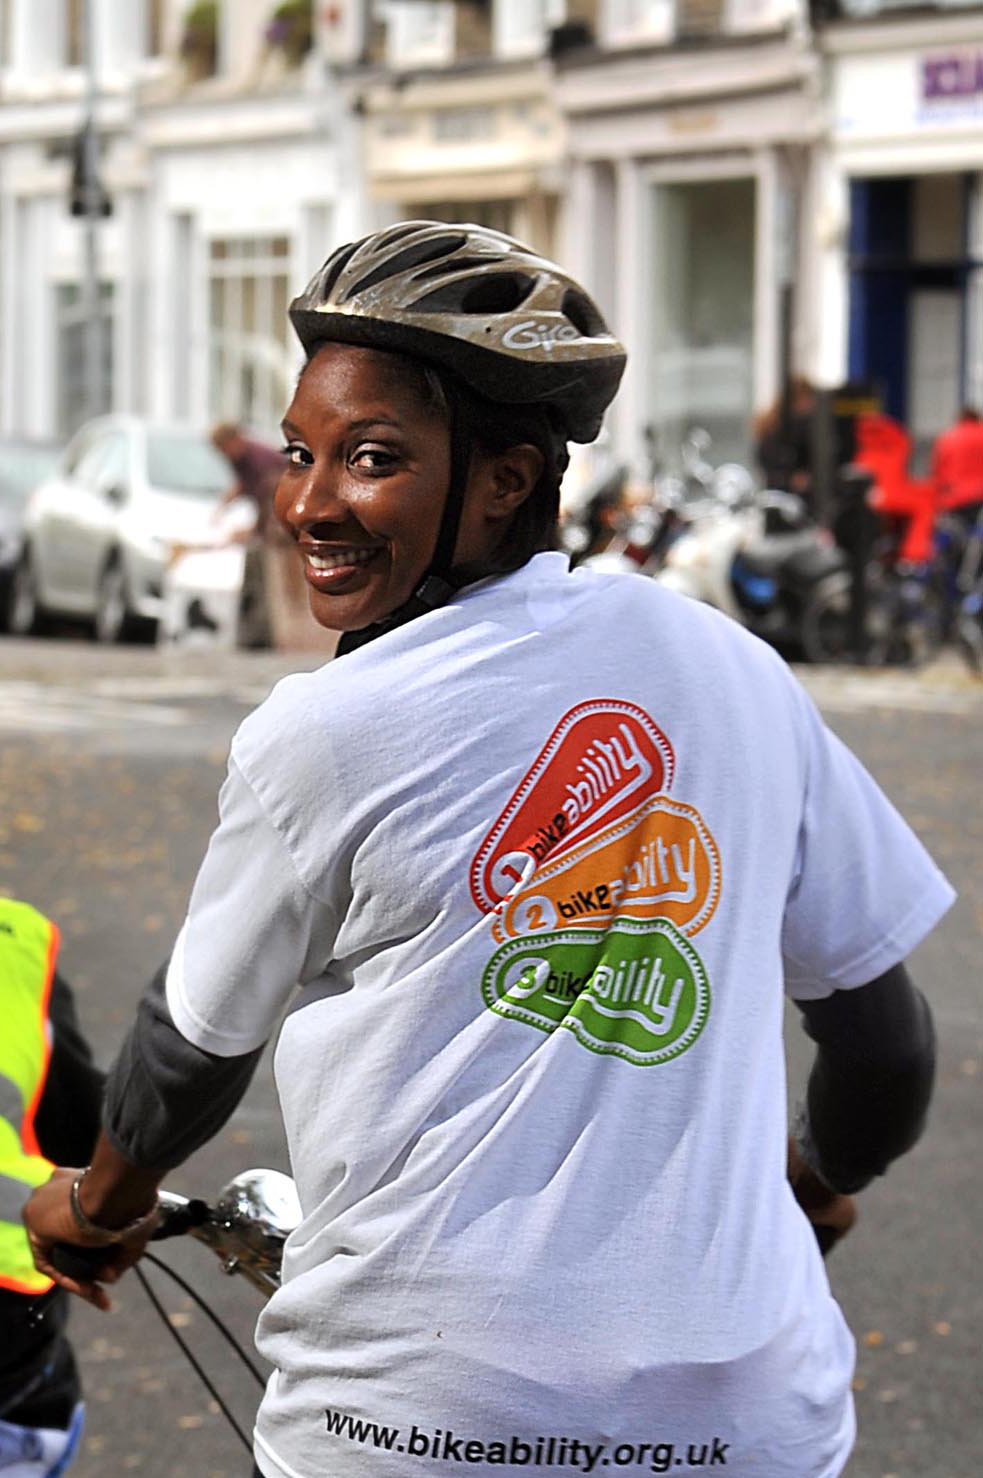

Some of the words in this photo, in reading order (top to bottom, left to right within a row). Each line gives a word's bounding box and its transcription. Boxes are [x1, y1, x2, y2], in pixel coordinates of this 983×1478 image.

[502, 320, 582, 351] Giro
[526, 723, 653, 862] bikeability
[526, 904, 548, 931] 2
[557, 836, 697, 923] bikeabilty
[324, 1408, 731, 1474] www.bikeability.org.uk
